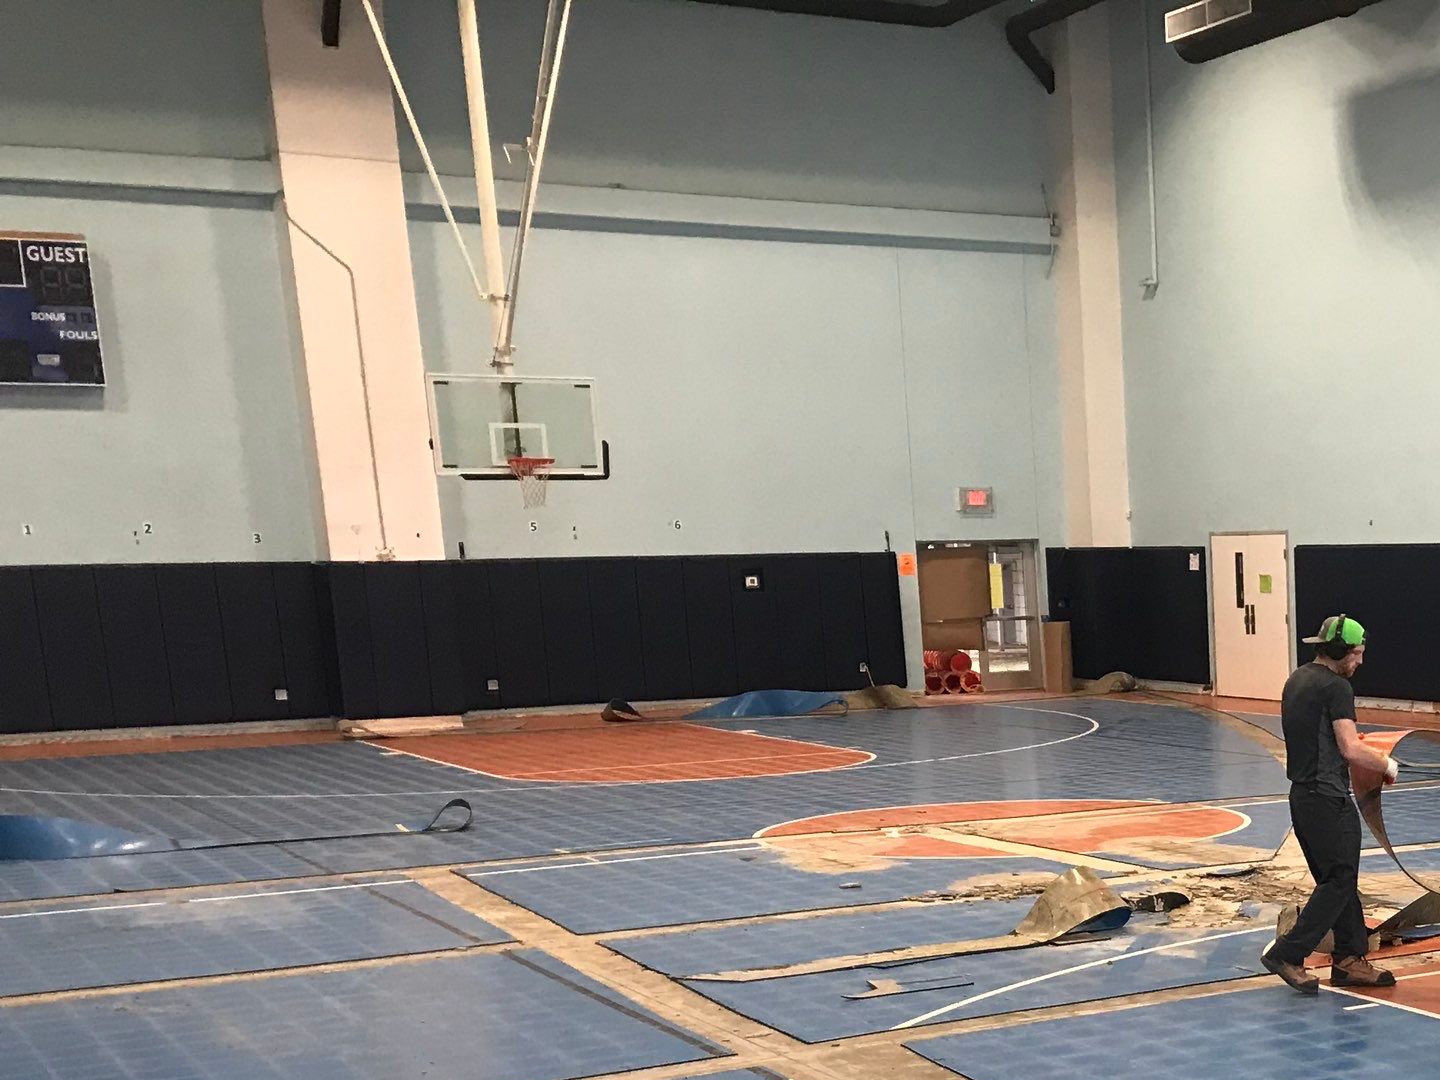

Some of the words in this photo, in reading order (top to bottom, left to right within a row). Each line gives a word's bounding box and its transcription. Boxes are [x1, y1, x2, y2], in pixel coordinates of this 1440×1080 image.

[26, 245, 86, 263] GUEST
[31, 312, 65, 321] BONUS
[59, 330, 97, 340] FOULS
[25, 525, 31, 535] 1
[144, 524, 152, 534] 2
[530, 522, 537, 532] 5
[674, 520, 681, 530] 6
[254, 534, 261, 544] 3
